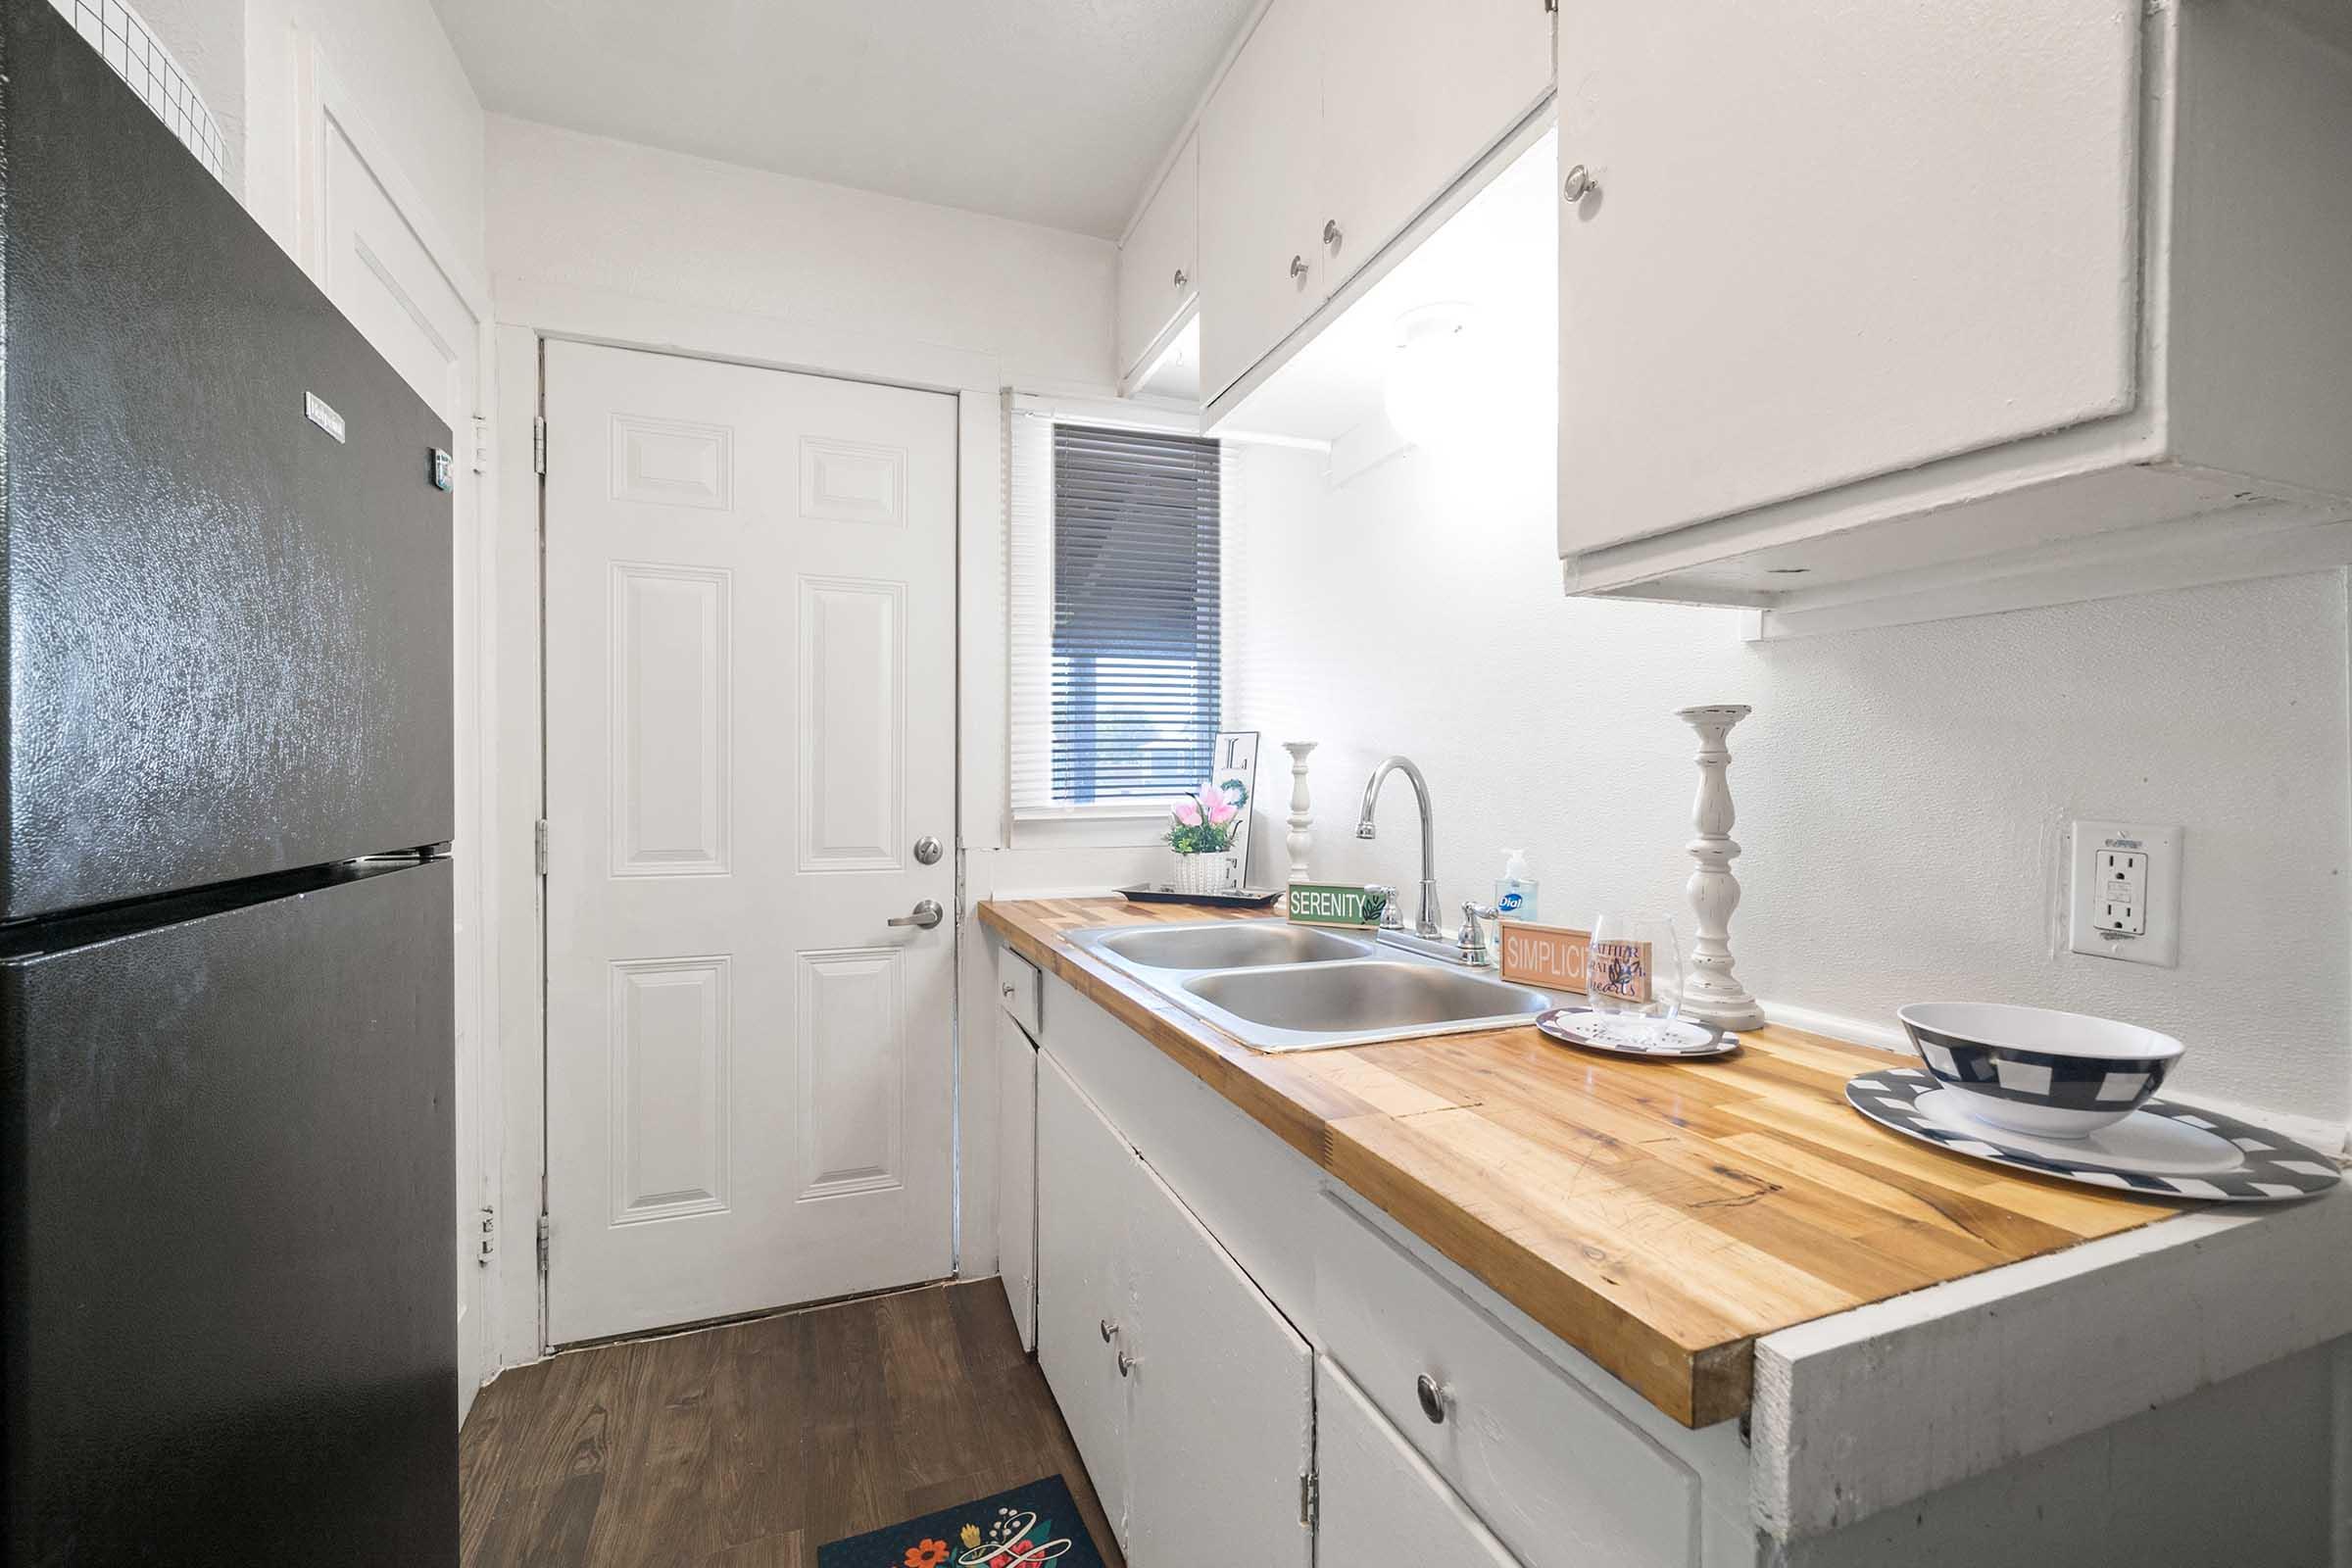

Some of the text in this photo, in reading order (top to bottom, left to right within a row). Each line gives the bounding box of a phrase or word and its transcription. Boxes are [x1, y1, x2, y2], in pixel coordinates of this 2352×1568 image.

[1291, 891, 1366, 918] SERENITY
[1499, 896, 1522, 907] Dial
[1507, 934, 1590, 979] SIMPLICI
